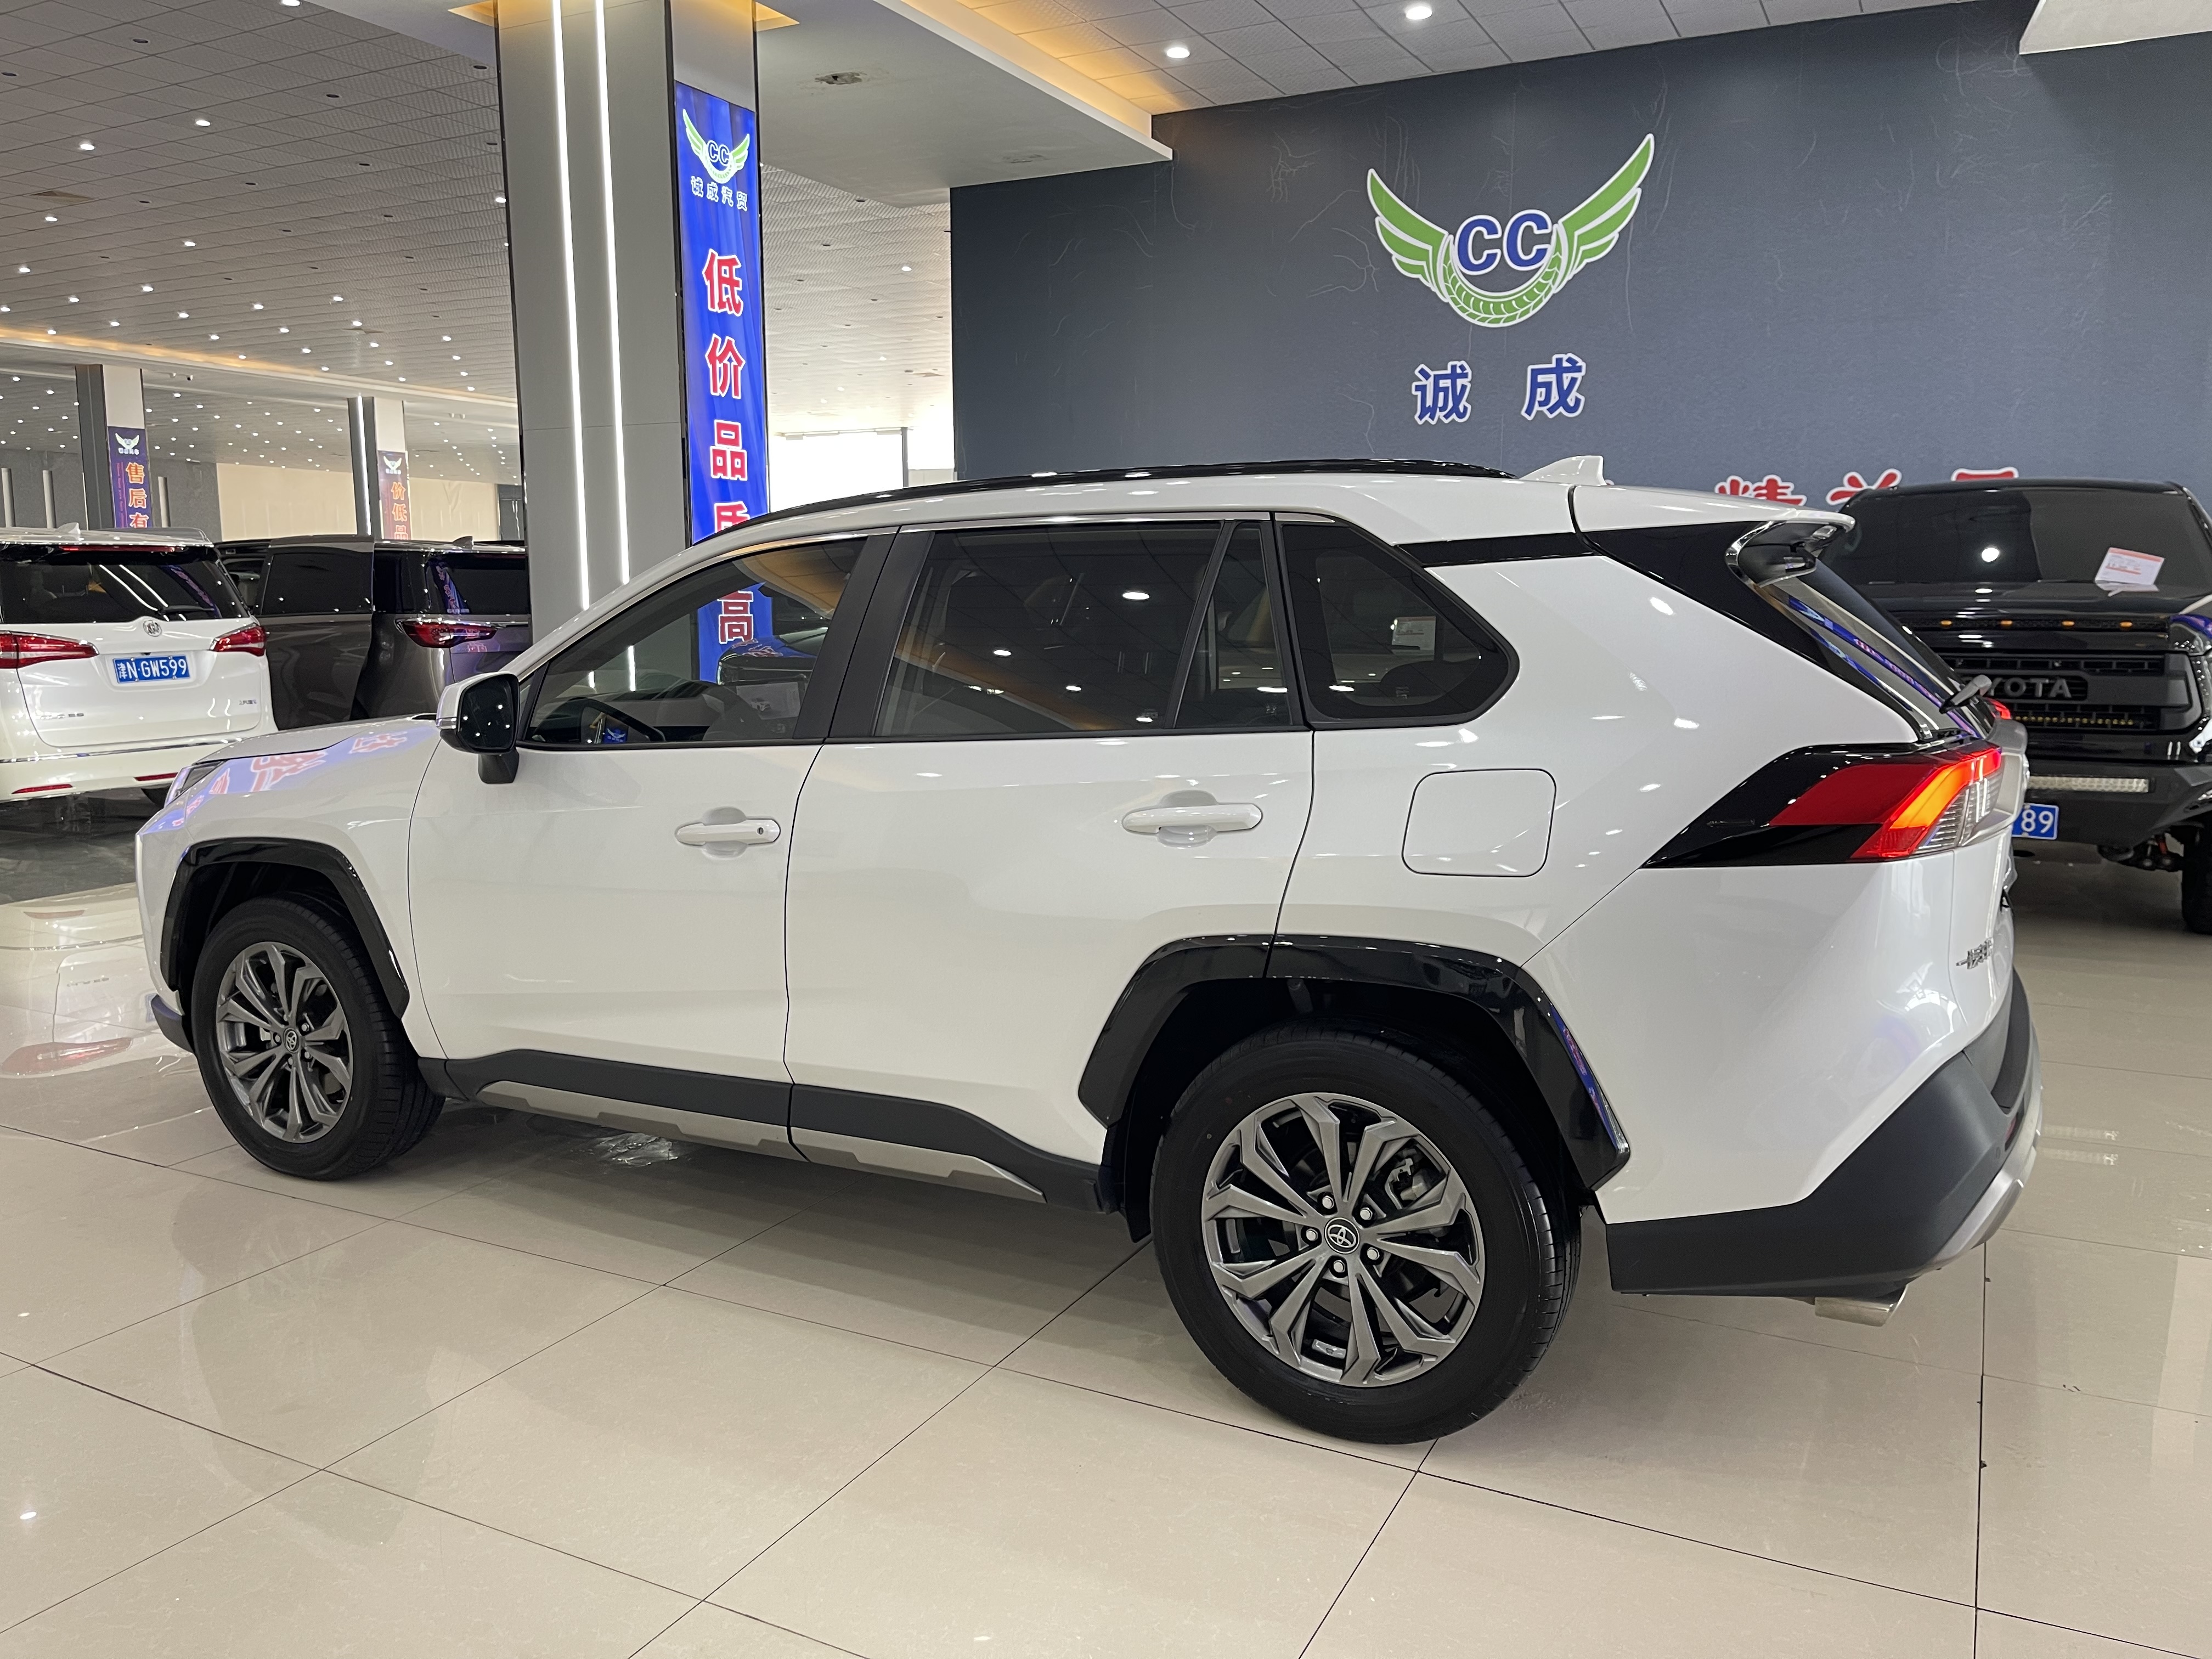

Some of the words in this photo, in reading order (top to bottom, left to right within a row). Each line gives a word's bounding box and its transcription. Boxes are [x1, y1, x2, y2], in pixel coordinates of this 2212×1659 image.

[707, 140, 730, 167] CC
[690, 176, 748, 212] 诚成汽贸
[1454, 209, 1552, 275] CC
